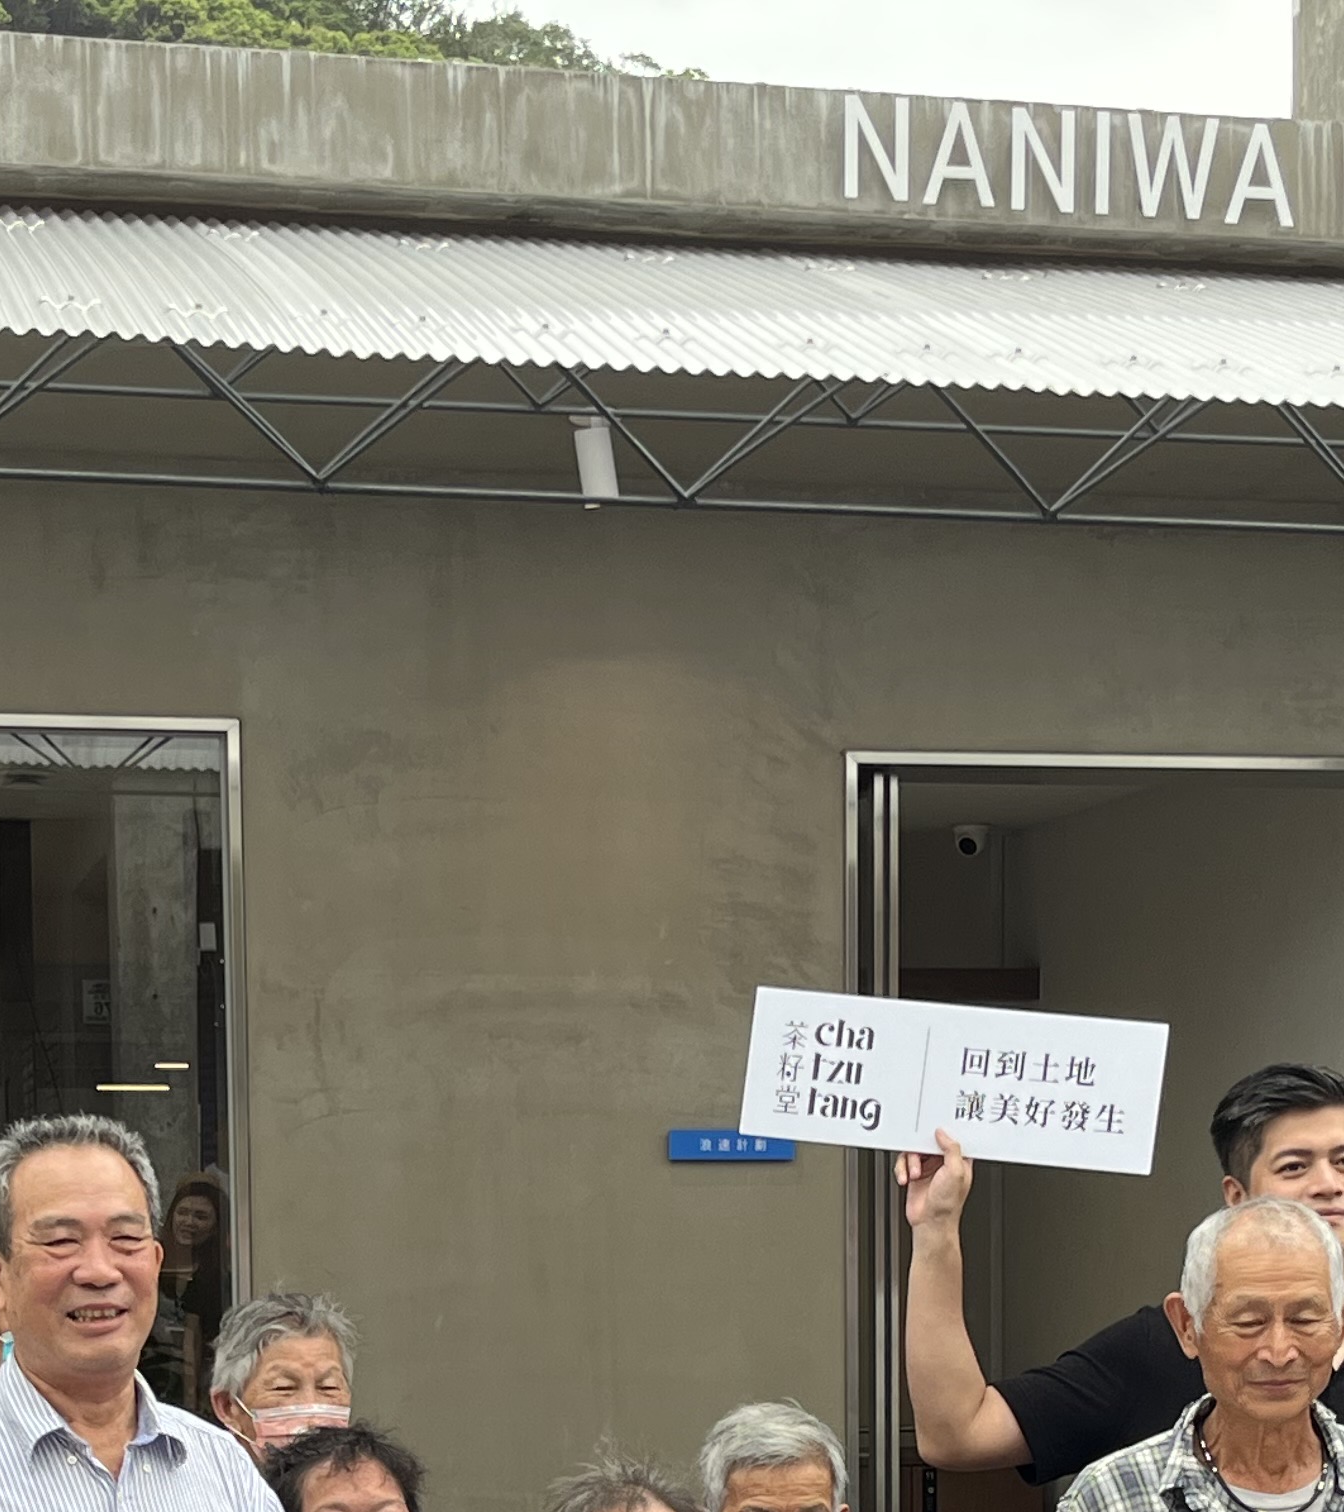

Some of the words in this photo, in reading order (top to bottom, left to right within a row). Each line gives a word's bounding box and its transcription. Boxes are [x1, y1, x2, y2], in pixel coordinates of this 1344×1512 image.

[843, 93, 1295, 228] NANIWA
[814, 1018, 875, 1051] cha
[812, 1052, 863, 1085] tzu
[961, 1046, 1097, 1087] 回到土地
[807, 1086, 882, 1131] tang
[955, 1089, 1126, 1135] 讓美好發生
